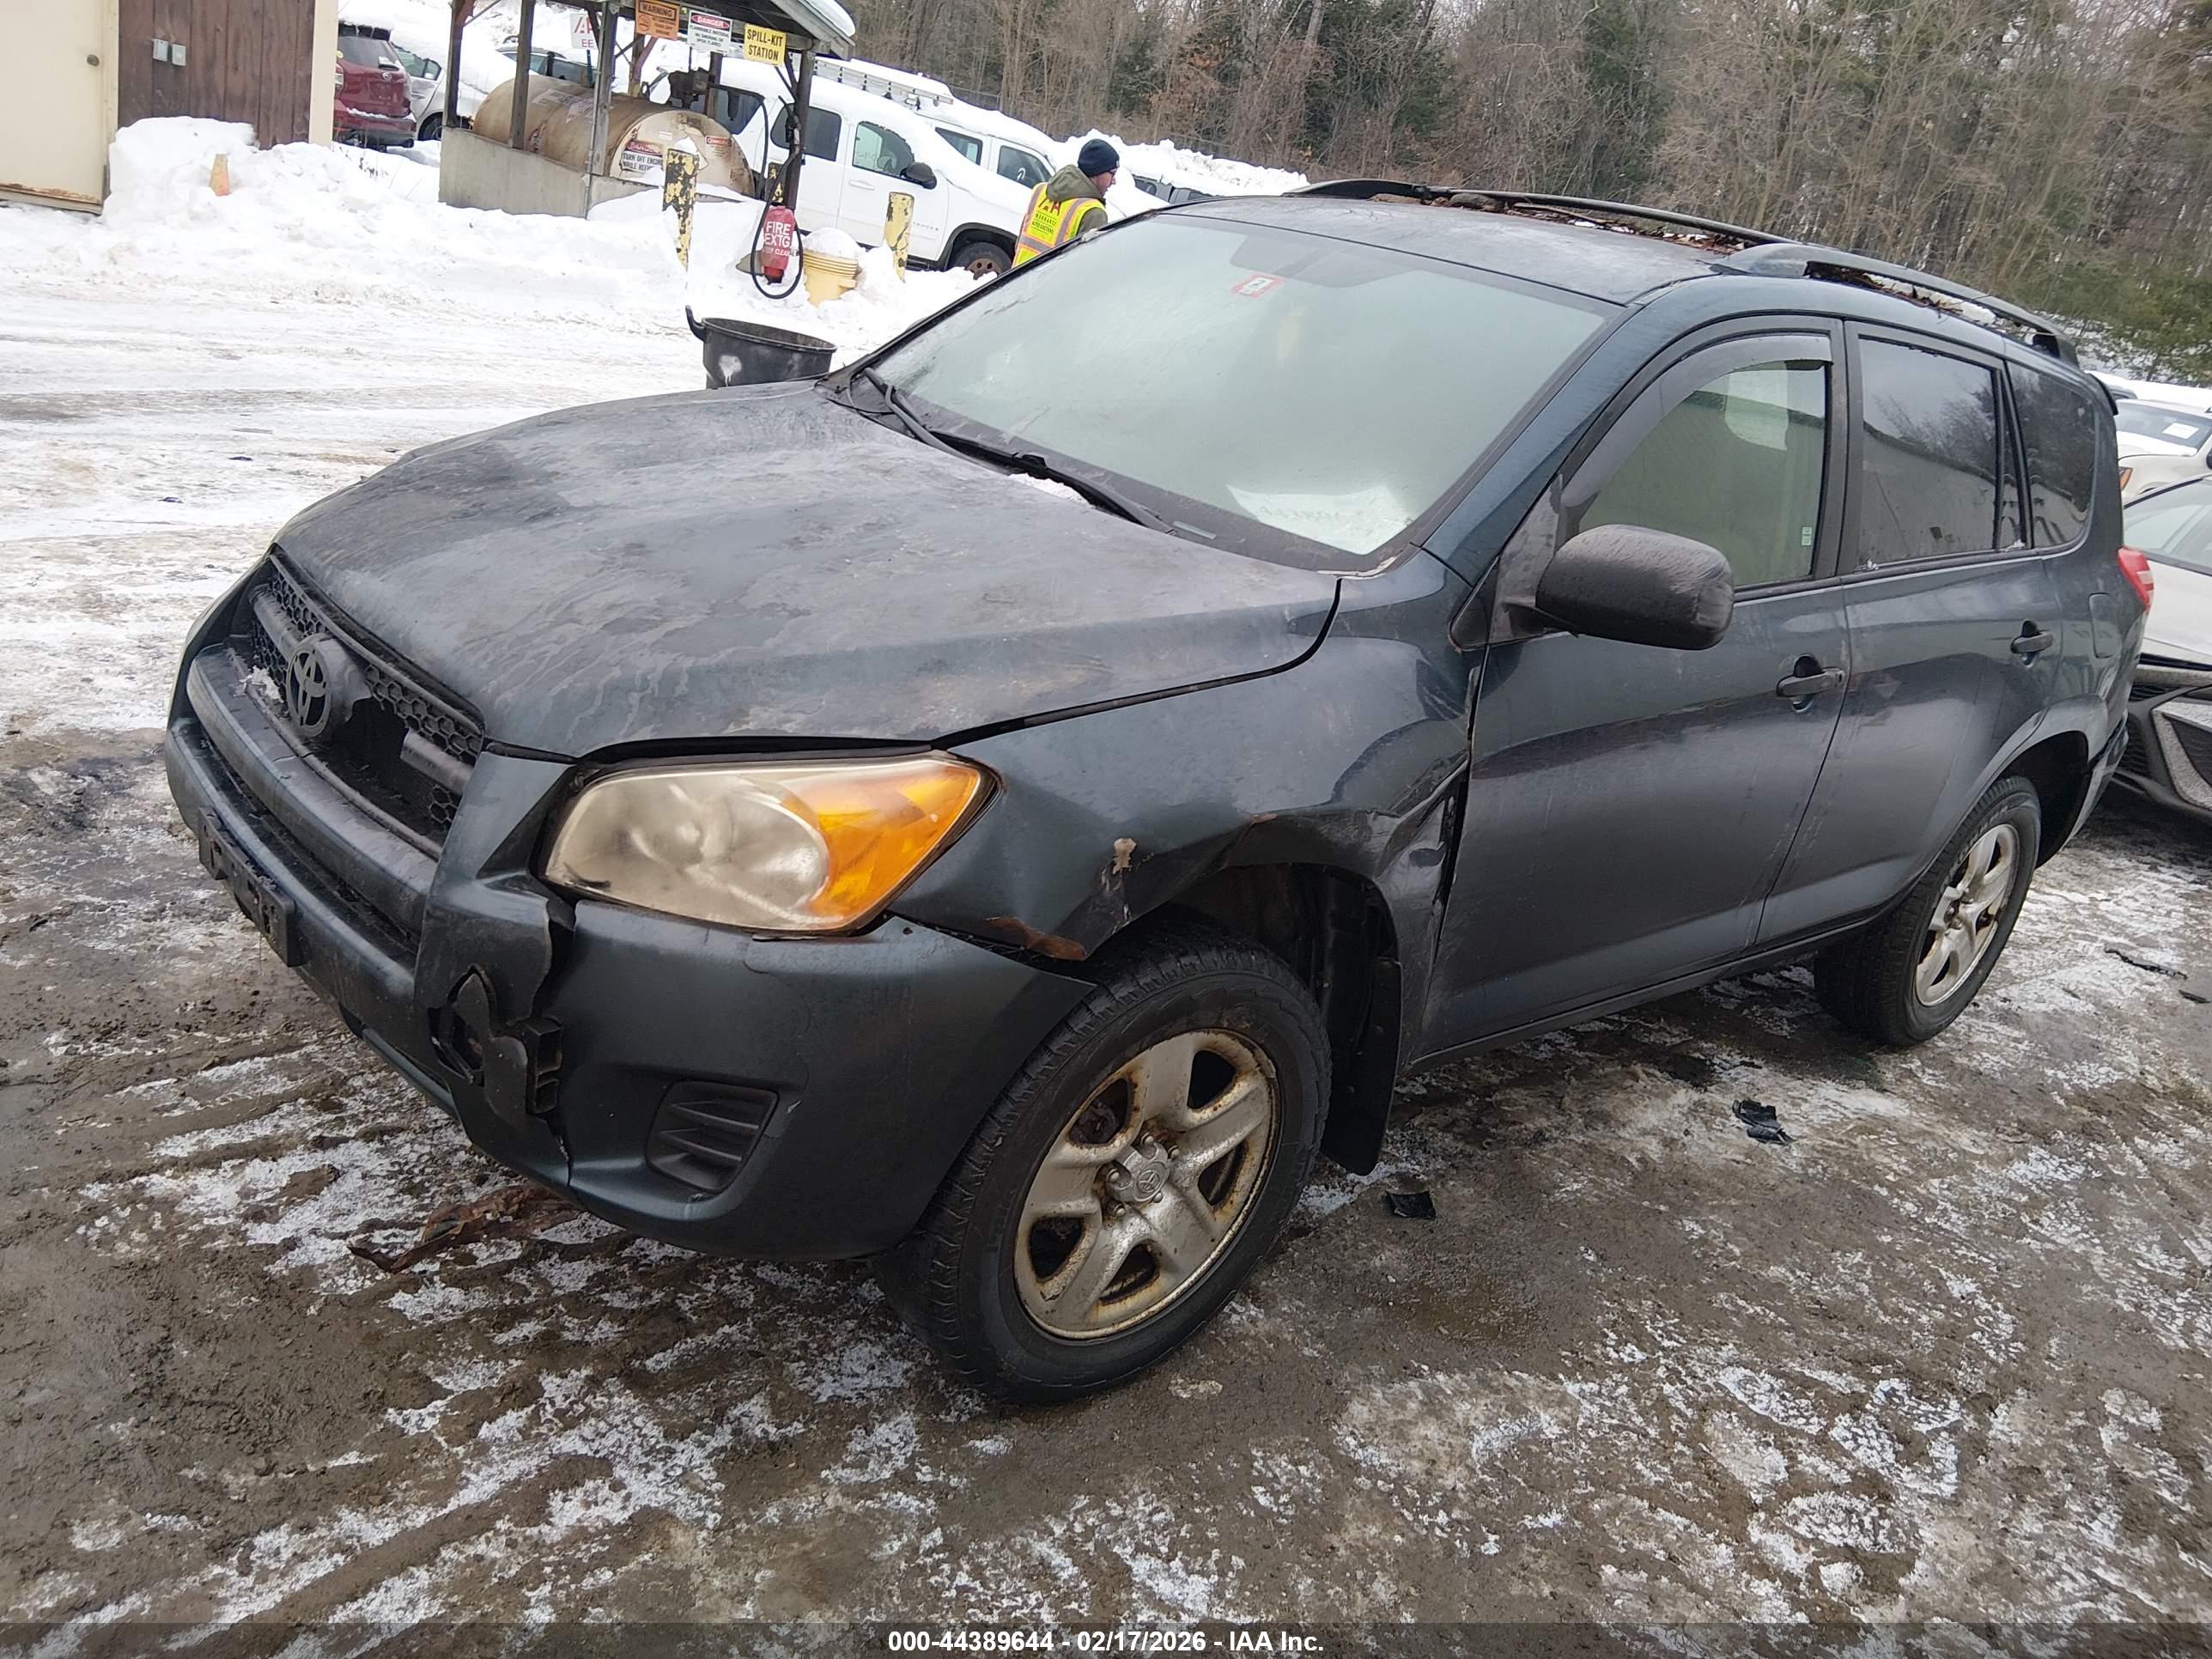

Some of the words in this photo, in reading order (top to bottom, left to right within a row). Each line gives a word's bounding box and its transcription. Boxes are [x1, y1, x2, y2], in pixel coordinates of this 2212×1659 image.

[641, 3, 672, 17] WARNING
[697, 15, 723, 27] DANGER
[747, 29, 783, 47] SPILL-KIT
[748, 44, 779, 61] STATION
[766, 222, 791, 236] FIRE
